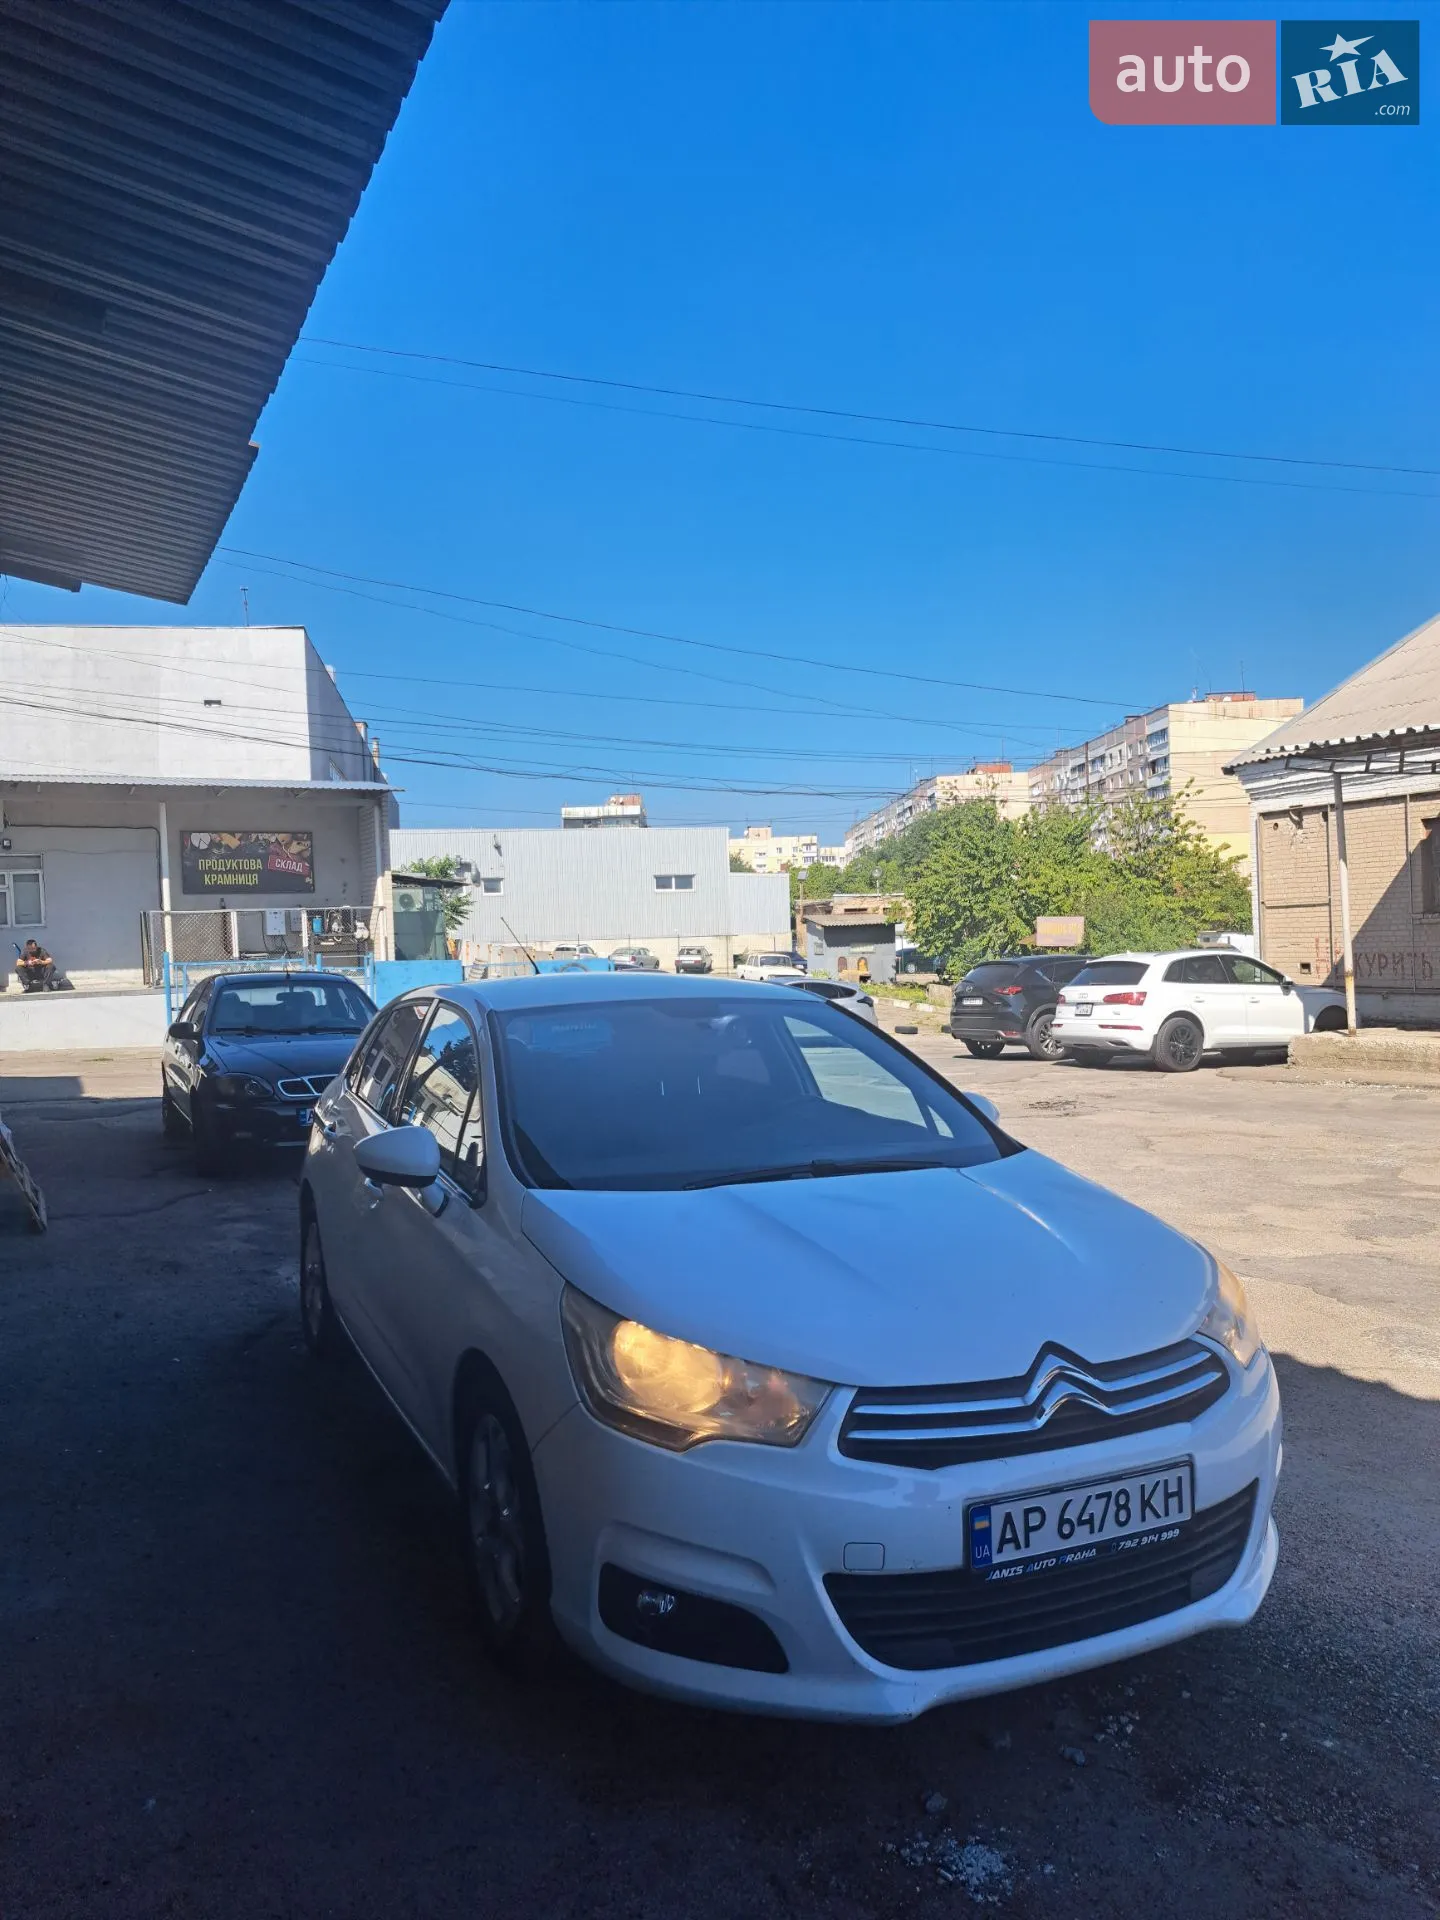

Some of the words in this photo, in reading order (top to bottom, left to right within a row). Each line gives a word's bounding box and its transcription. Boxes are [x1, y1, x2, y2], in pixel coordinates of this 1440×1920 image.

[198, 858, 263, 871] ПРОДУКТОВА
[275, 858, 303, 873] СКЛАД
[204, 873, 259, 886] КРАМНИЦЯ
[996, 1505, 1047, 1554] AP
[1057, 1488, 1131, 1540] 6478
[1140, 1475, 1184, 1522] KH
[975, 1544, 991, 1559] UA
[985, 1565, 1024, 1581] JANIS
[1026, 1558, 1057, 1573] AUTO
[1059, 1548, 1097, 1565] PRAHA
